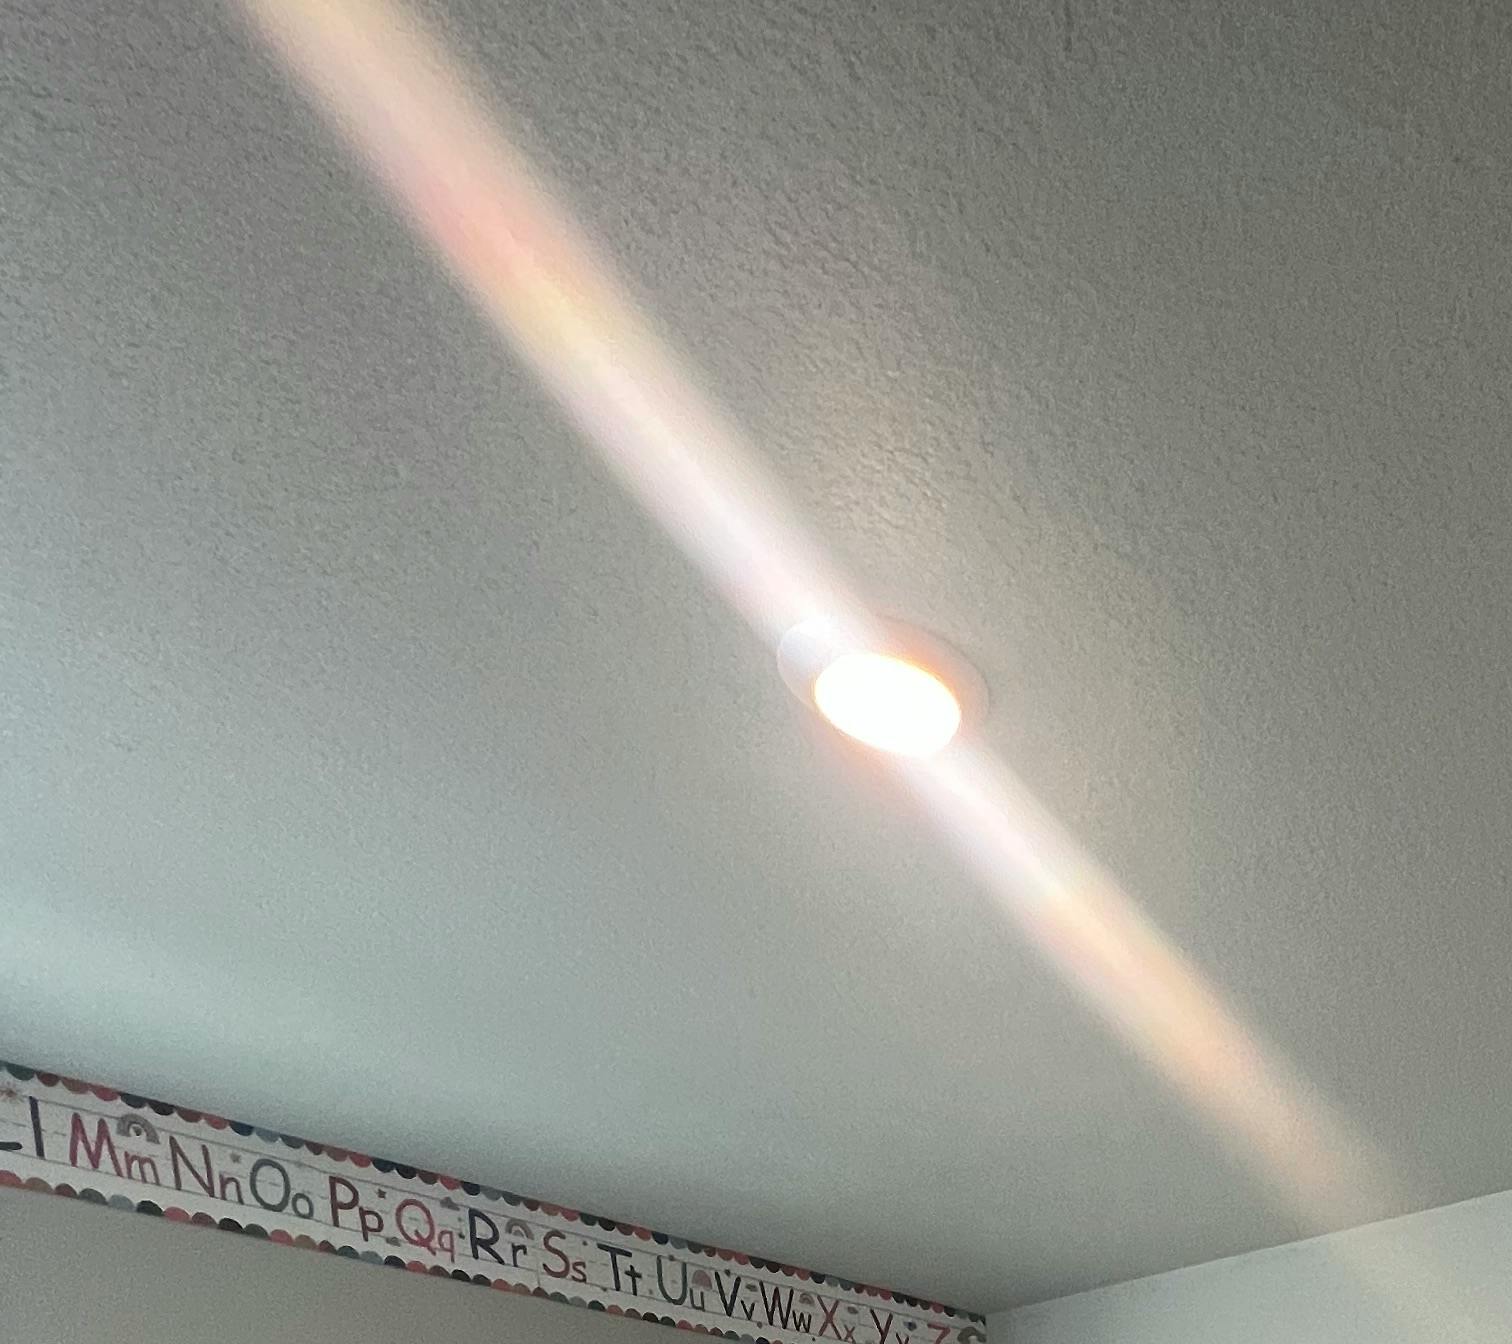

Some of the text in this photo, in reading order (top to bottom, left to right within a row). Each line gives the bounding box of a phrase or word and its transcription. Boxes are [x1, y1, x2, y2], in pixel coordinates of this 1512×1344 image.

[69, 1112, 162, 1186] Mm
[167, 1135, 246, 1206] Nn
[248, 1157, 315, 1220] Oo
[328, 1174, 385, 1243] Pp
[395, 1198, 456, 1264] Qq
[467, 1207, 528, 1270] Rr
[541, 1229, 588, 1284] Ss
[596, 1241, 643, 1297] Tt
[655, 1254, 706, 1312] Uu
[714, 1270, 756, 1322] Vv
[758, 1279, 813, 1334] Ww
[816, 1295, 857, 1344] Xx
